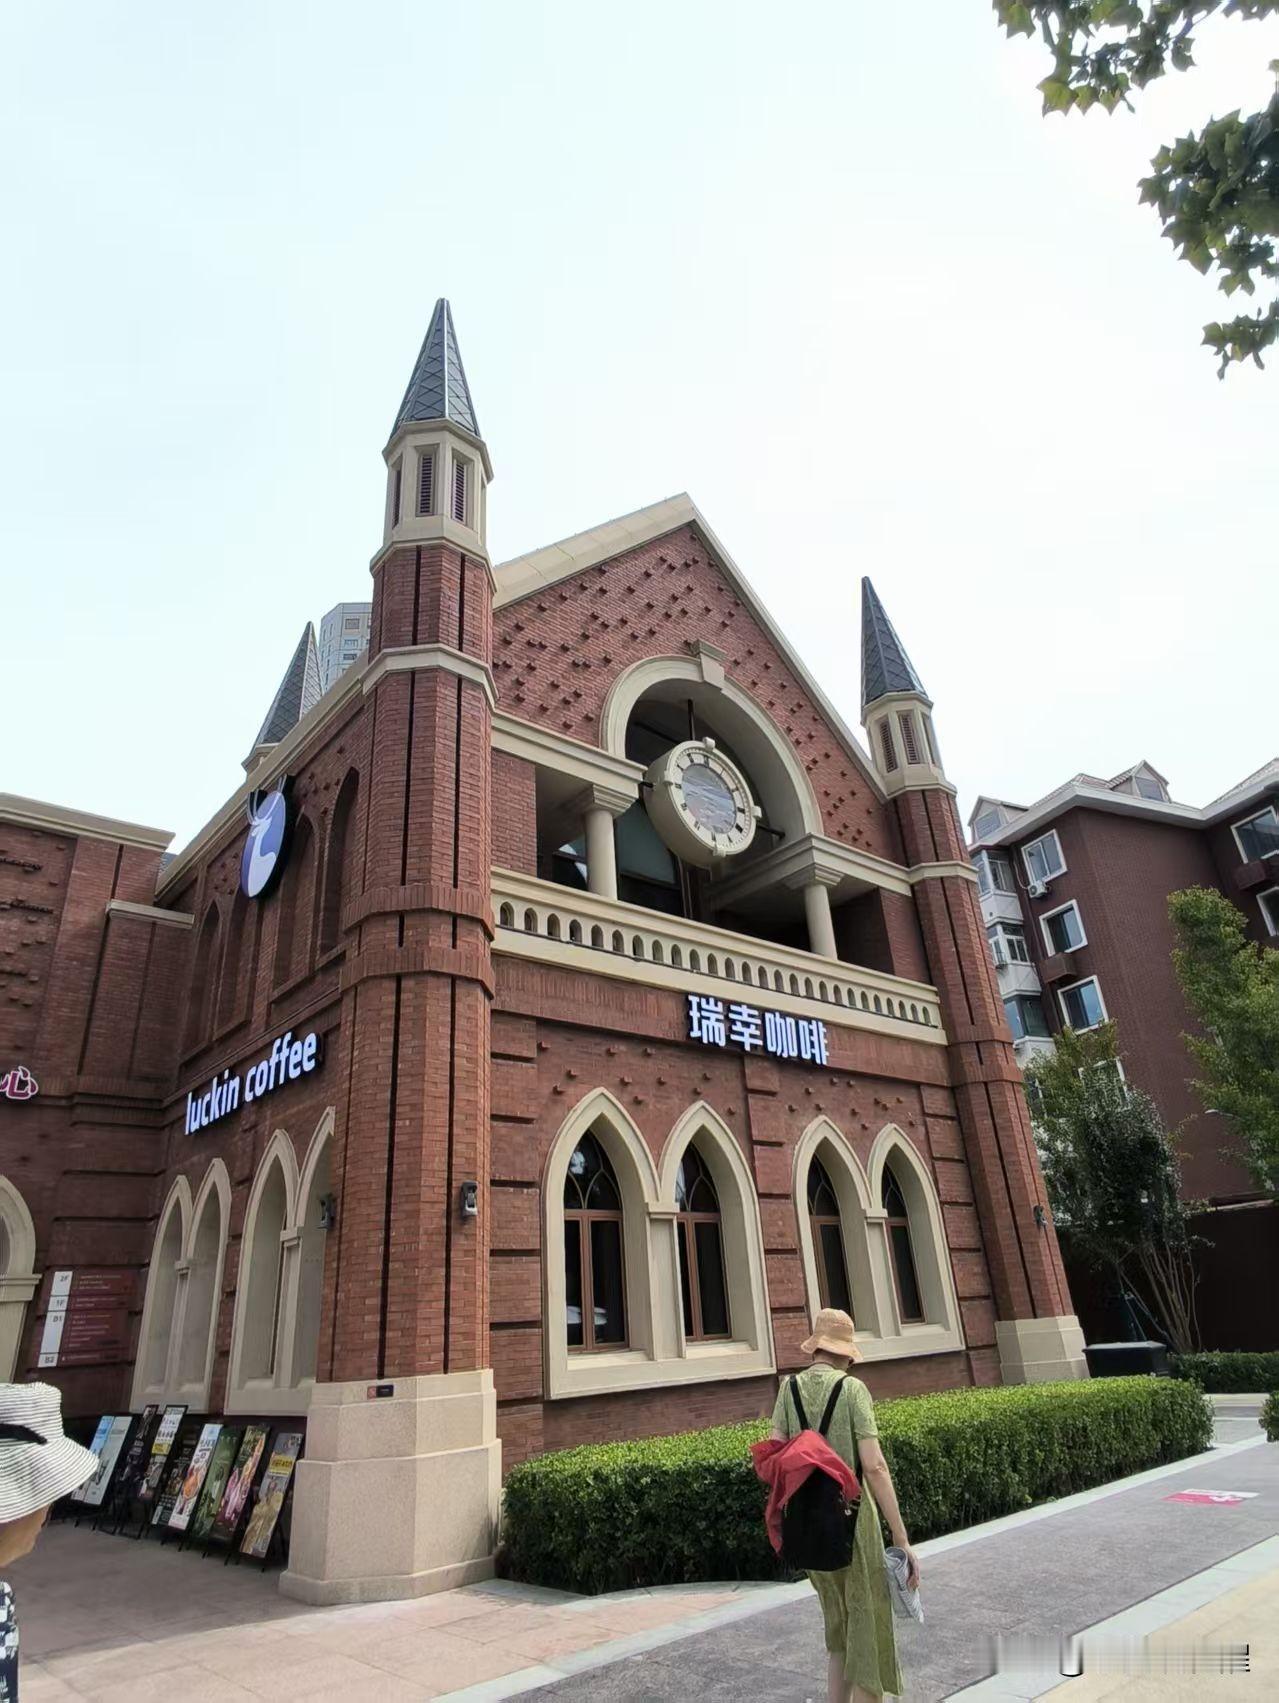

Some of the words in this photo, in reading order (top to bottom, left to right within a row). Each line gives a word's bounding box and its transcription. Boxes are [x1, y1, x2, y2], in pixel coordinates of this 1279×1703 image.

[688, 994, 830, 1065] 瑞幸咖啡
[184, 1069, 240, 1135] luckin
[245, 1031, 317, 1102] coffee
